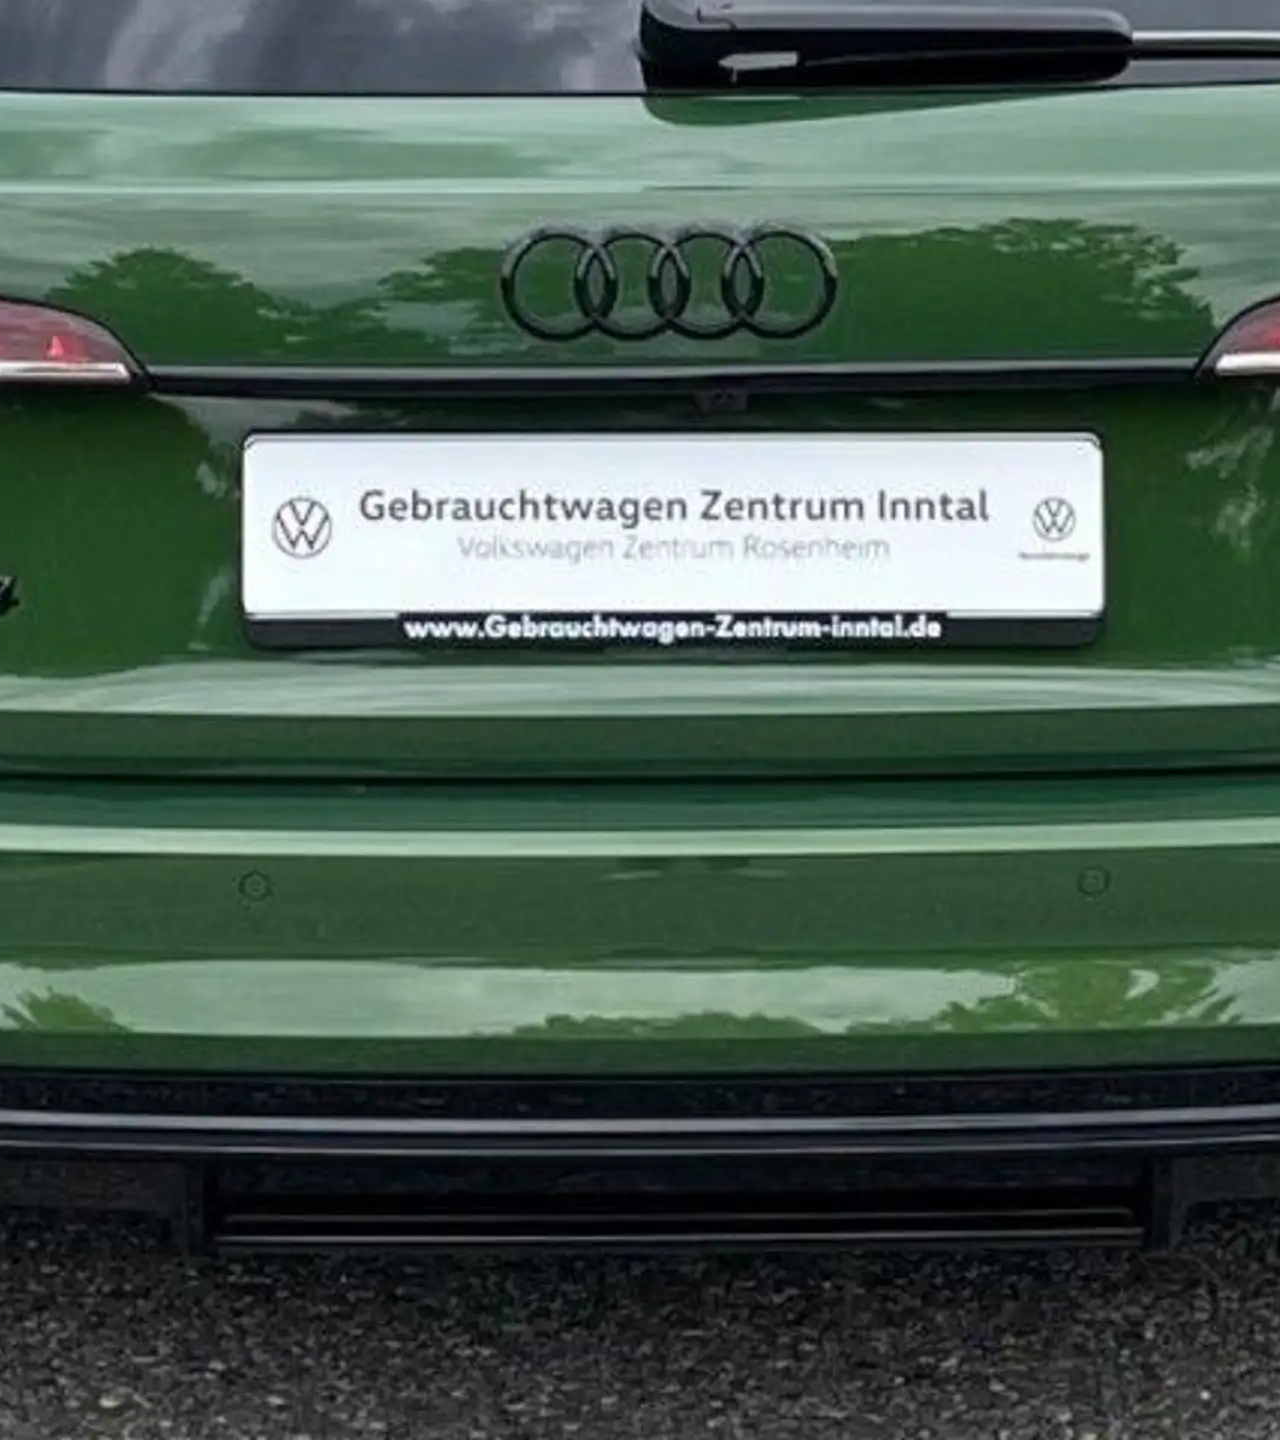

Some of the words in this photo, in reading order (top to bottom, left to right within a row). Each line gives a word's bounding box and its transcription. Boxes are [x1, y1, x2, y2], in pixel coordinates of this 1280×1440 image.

[359, 488, 688, 530] Gebrauchtwagen
[700, 489, 865, 521] Zentrum
[878, 489, 990, 522] Inntal
[456, 534, 615, 565] Volkswagen
[621, 533, 735, 561] Zentrum
[742, 532, 890, 561] Rosenheim
[403, 613, 942, 645] www.Gebrauchtwagen-Zentrum-inntal.de
